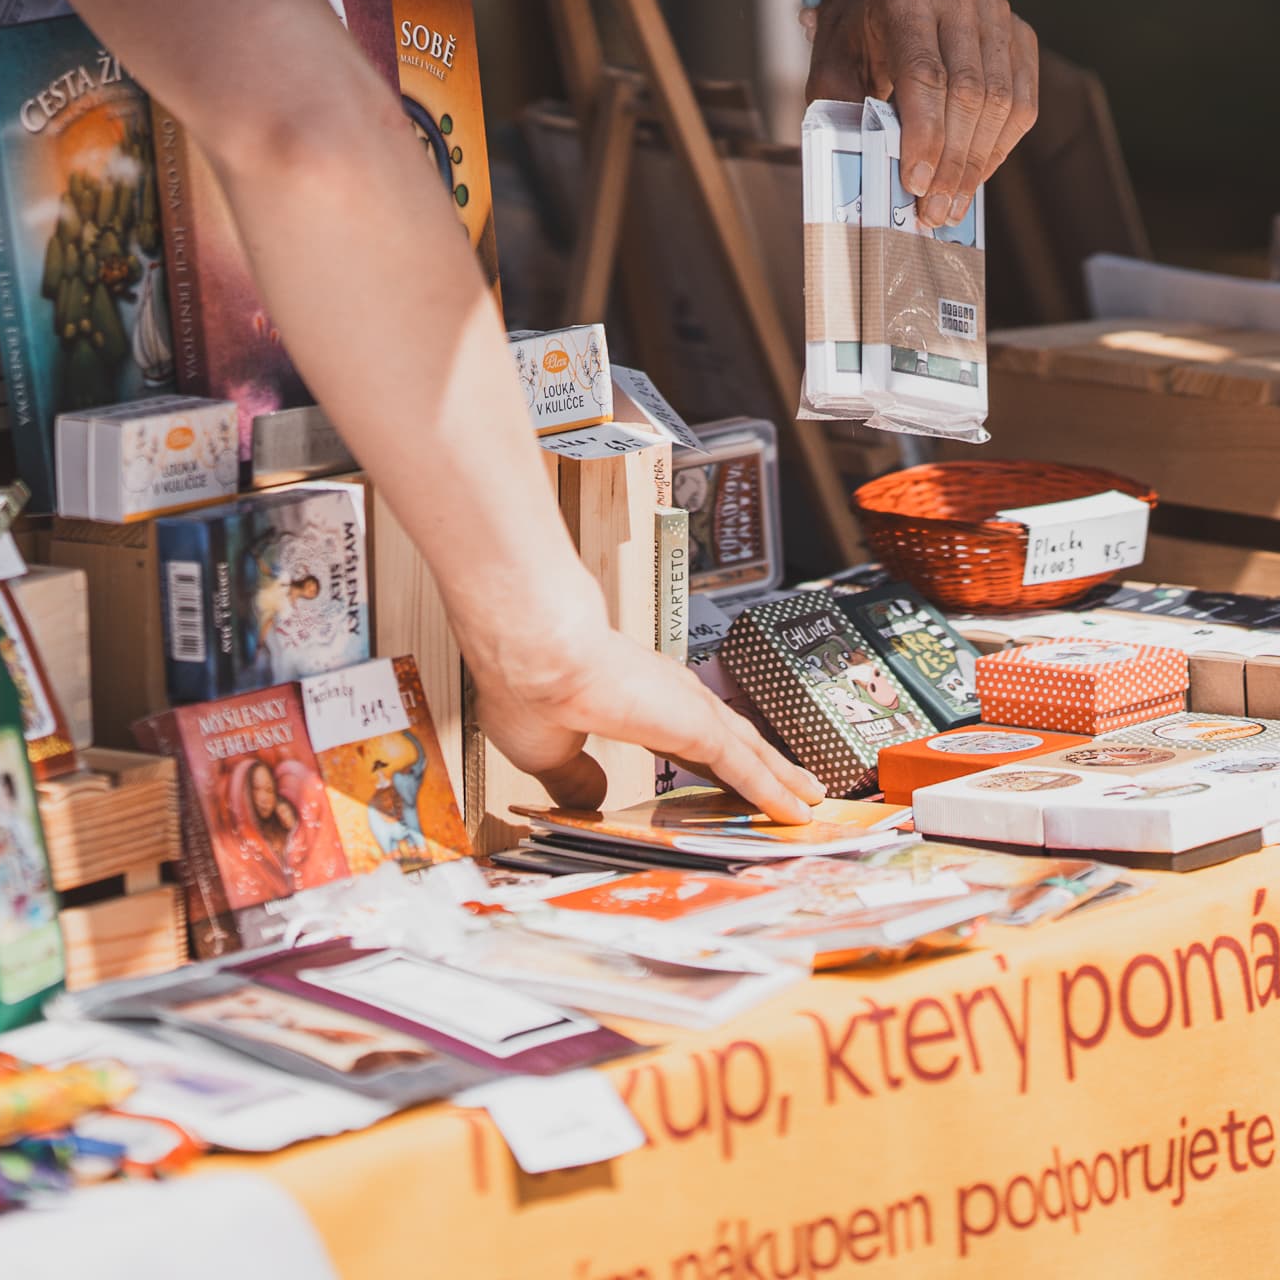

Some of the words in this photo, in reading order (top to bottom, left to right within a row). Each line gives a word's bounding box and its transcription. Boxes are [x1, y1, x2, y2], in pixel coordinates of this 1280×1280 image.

[400, 20, 457, 68] SOBĚ
[20, 63, 96, 134] CESTA
[536, 403, 543, 416] V
[545, 395, 585, 415] KULIČCE
[543, 381, 576, 399] LOUKA
[670, 548, 685, 642] KVARTETO
[198, 698, 287, 737] MYŠLENKY
[802, 955, 1032, 1106] který
[956, 1108, 1277, 1259] podporujete
